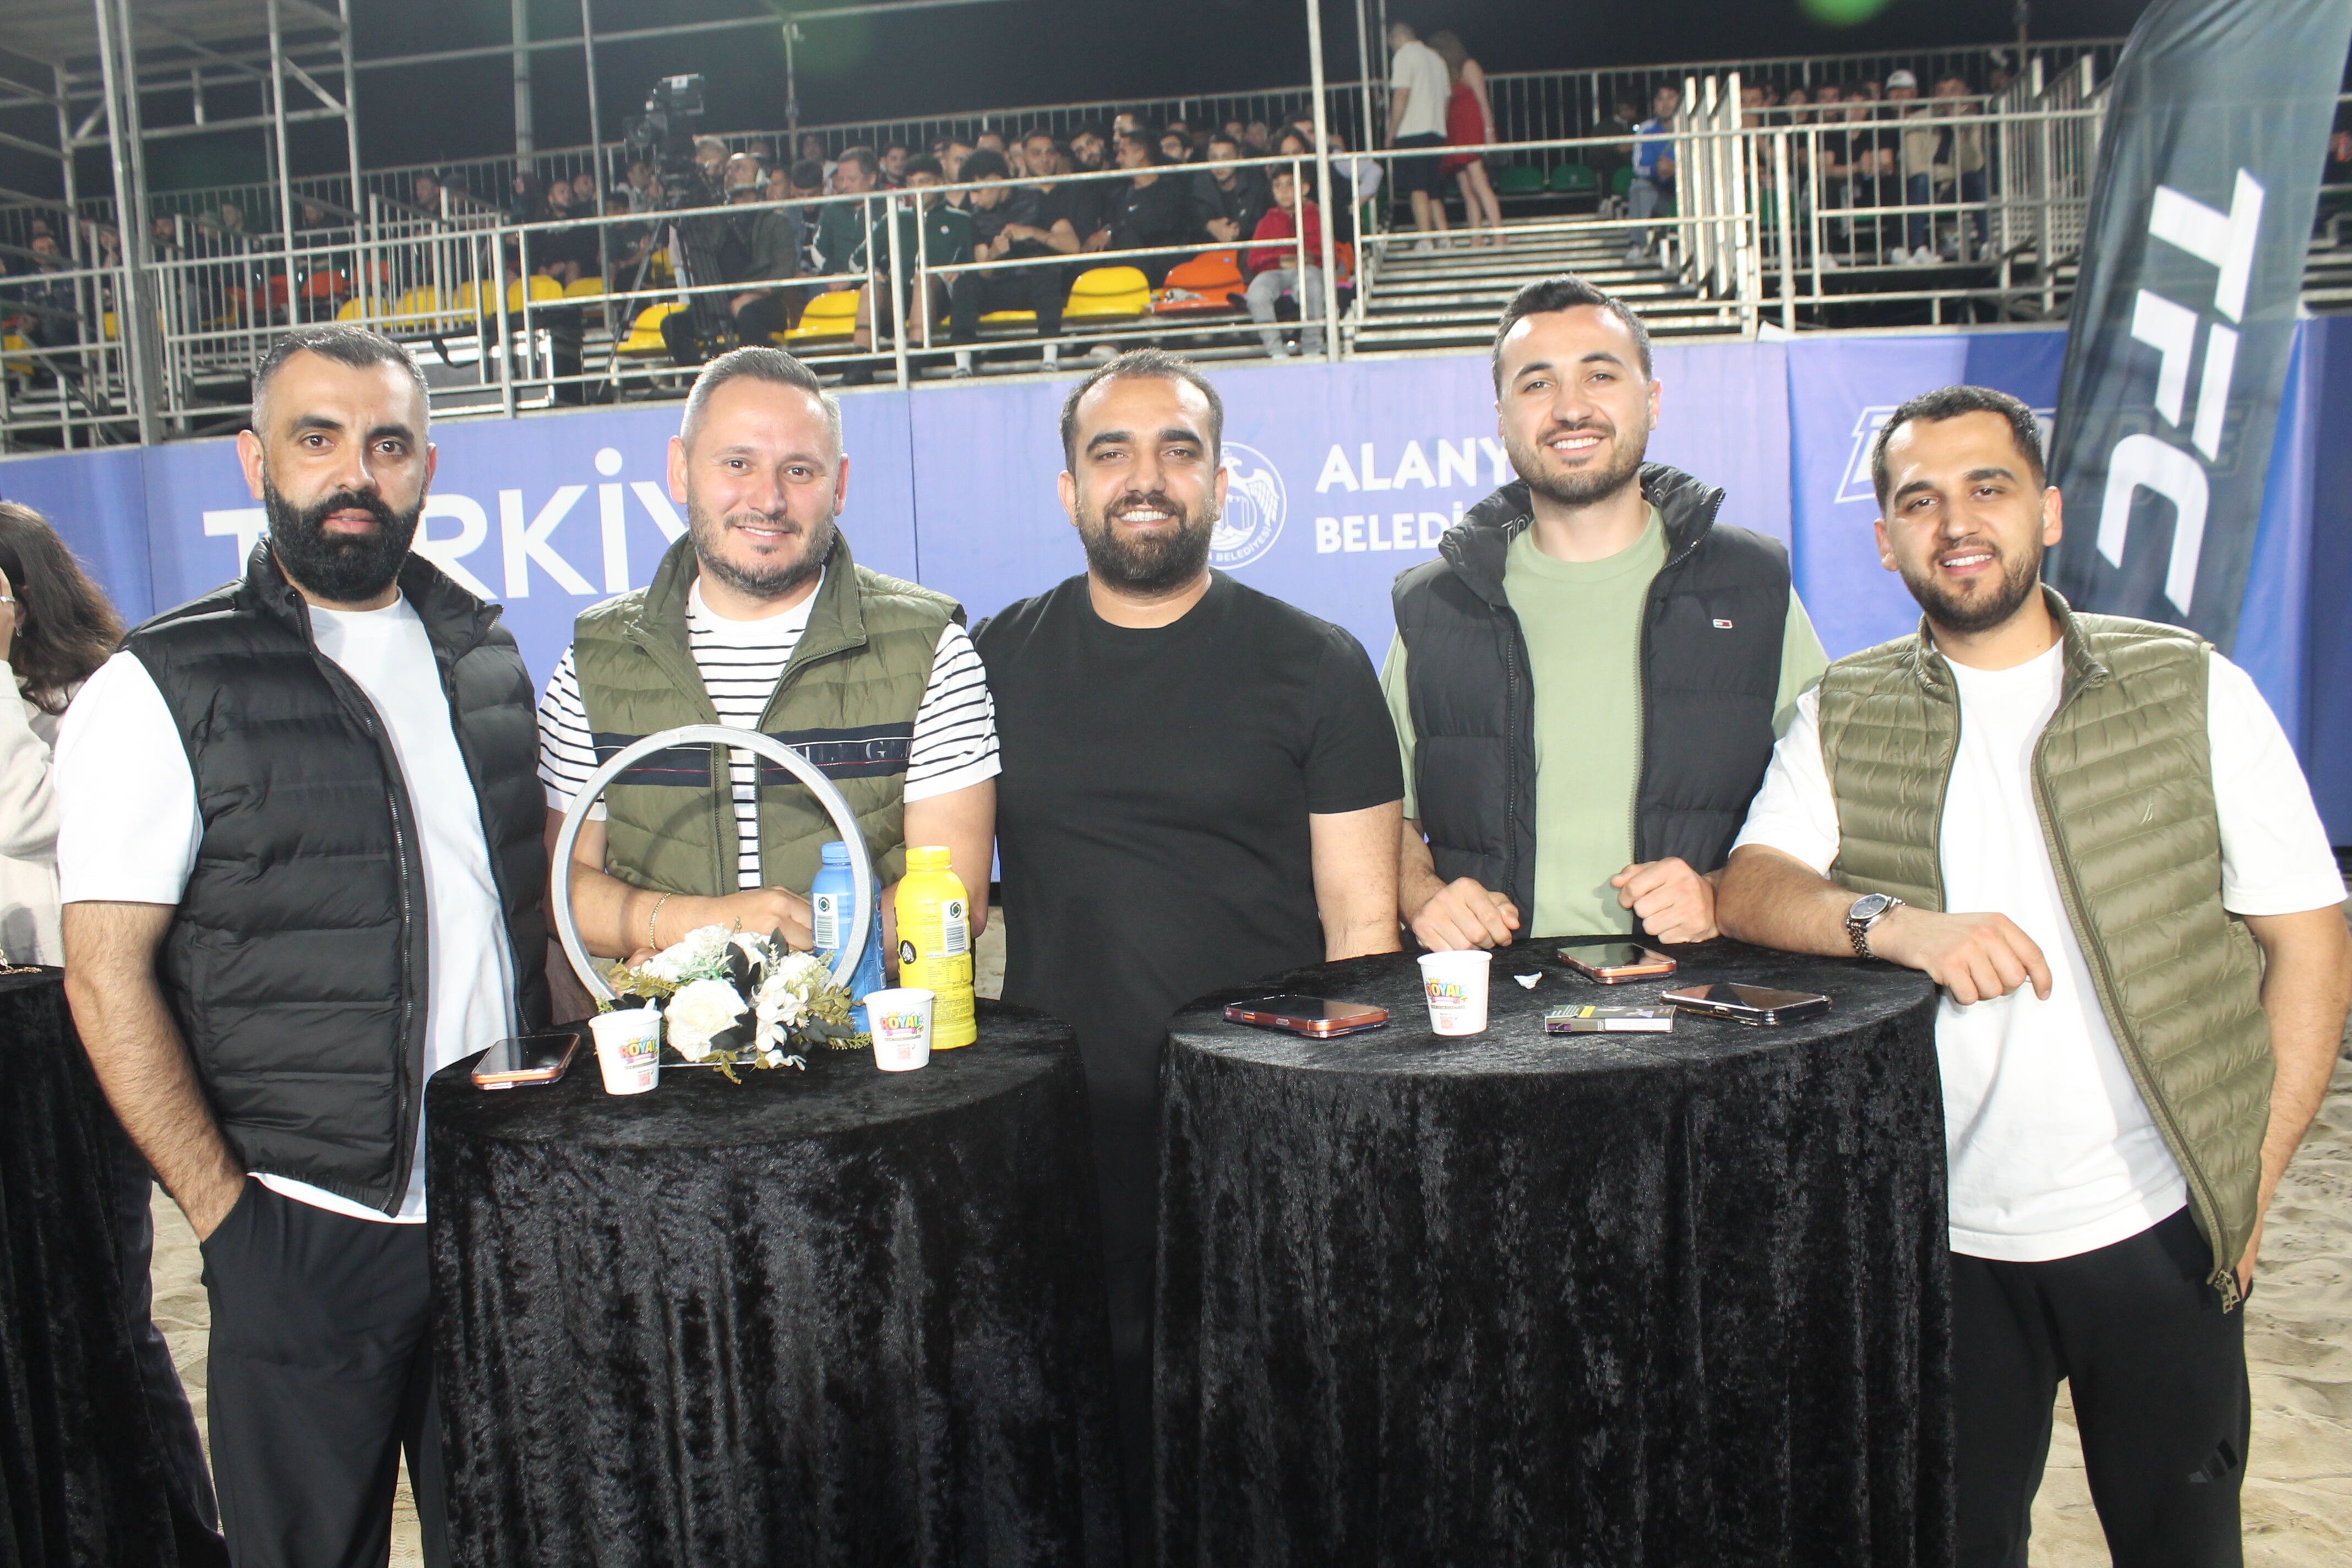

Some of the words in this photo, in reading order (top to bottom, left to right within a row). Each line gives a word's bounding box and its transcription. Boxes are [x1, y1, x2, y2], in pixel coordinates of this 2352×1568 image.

[1315, 437, 1520, 494] ALANY
[1426, 983, 1462, 998] ROYAL
[880, 1015, 919, 1030] ROYAL
[618, 1040, 657, 1058] ROYAL
